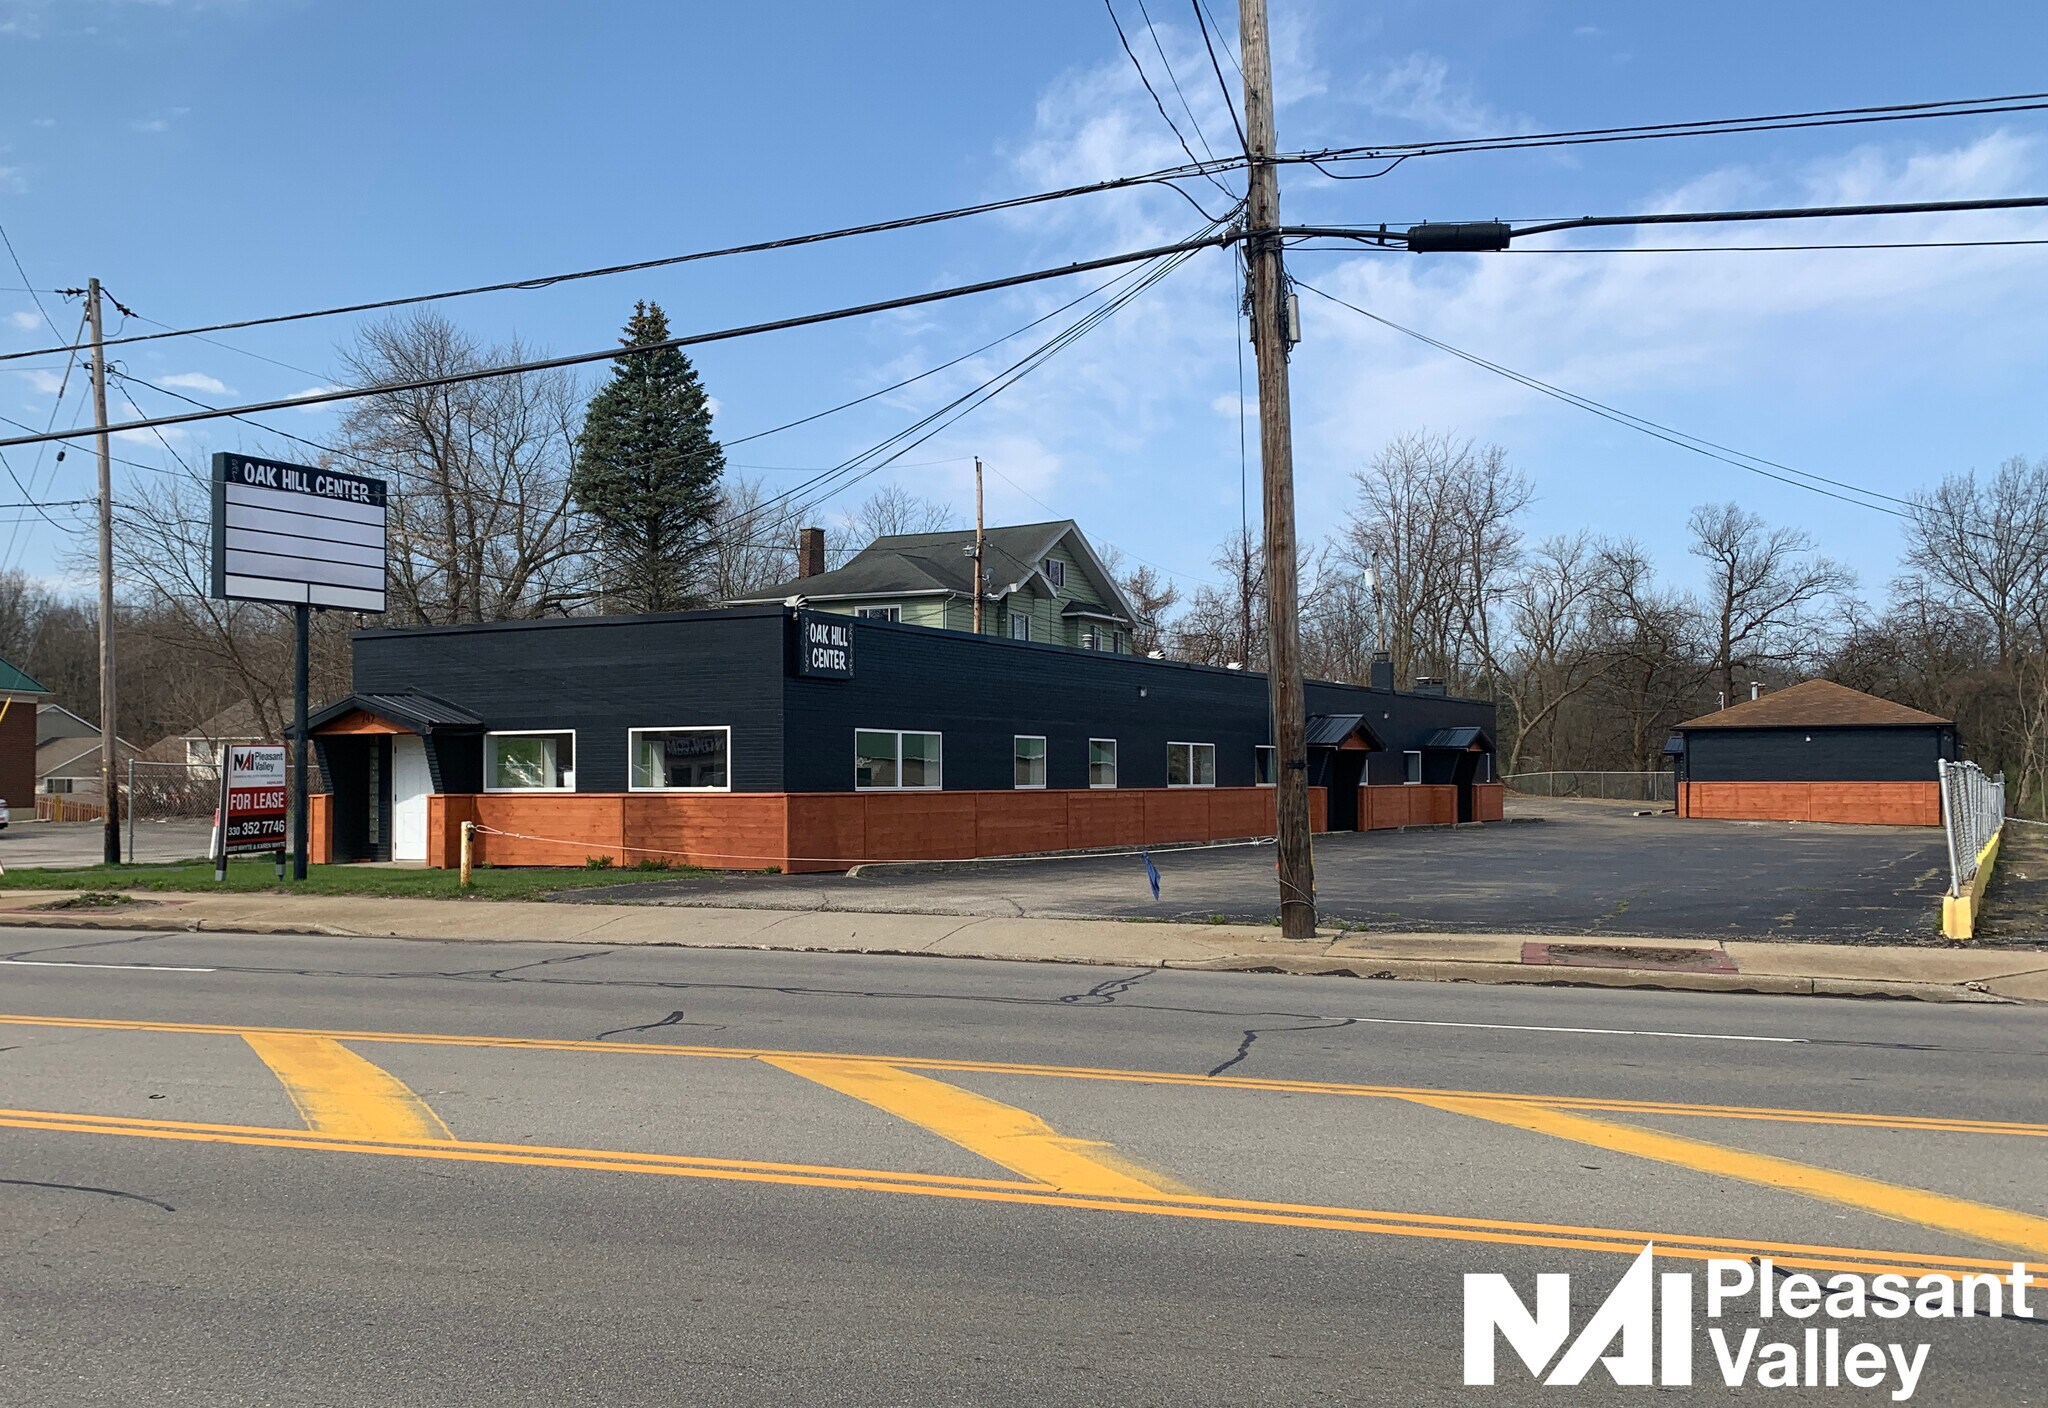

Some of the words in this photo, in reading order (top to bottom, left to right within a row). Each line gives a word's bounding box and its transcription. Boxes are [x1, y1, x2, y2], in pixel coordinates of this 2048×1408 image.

[244, 462, 277, 487] OAK
[282, 469, 311, 493] HILL
[315, 475, 370, 503] CENTER
[810, 622, 829, 644] OAK
[831, 625, 848, 647] HILL
[812, 647, 846, 670] CENTER
[234, 749, 254, 771] NAI
[255, 751, 283, 761] Pleasant
[255, 762, 274, 772] Valley
[230, 793, 251, 810] FOR
[254, 792, 284, 809] LEASE
[228, 826, 240, 836] 330
[242, 821, 260, 835] 352
[262, 819, 285, 834] 7746
